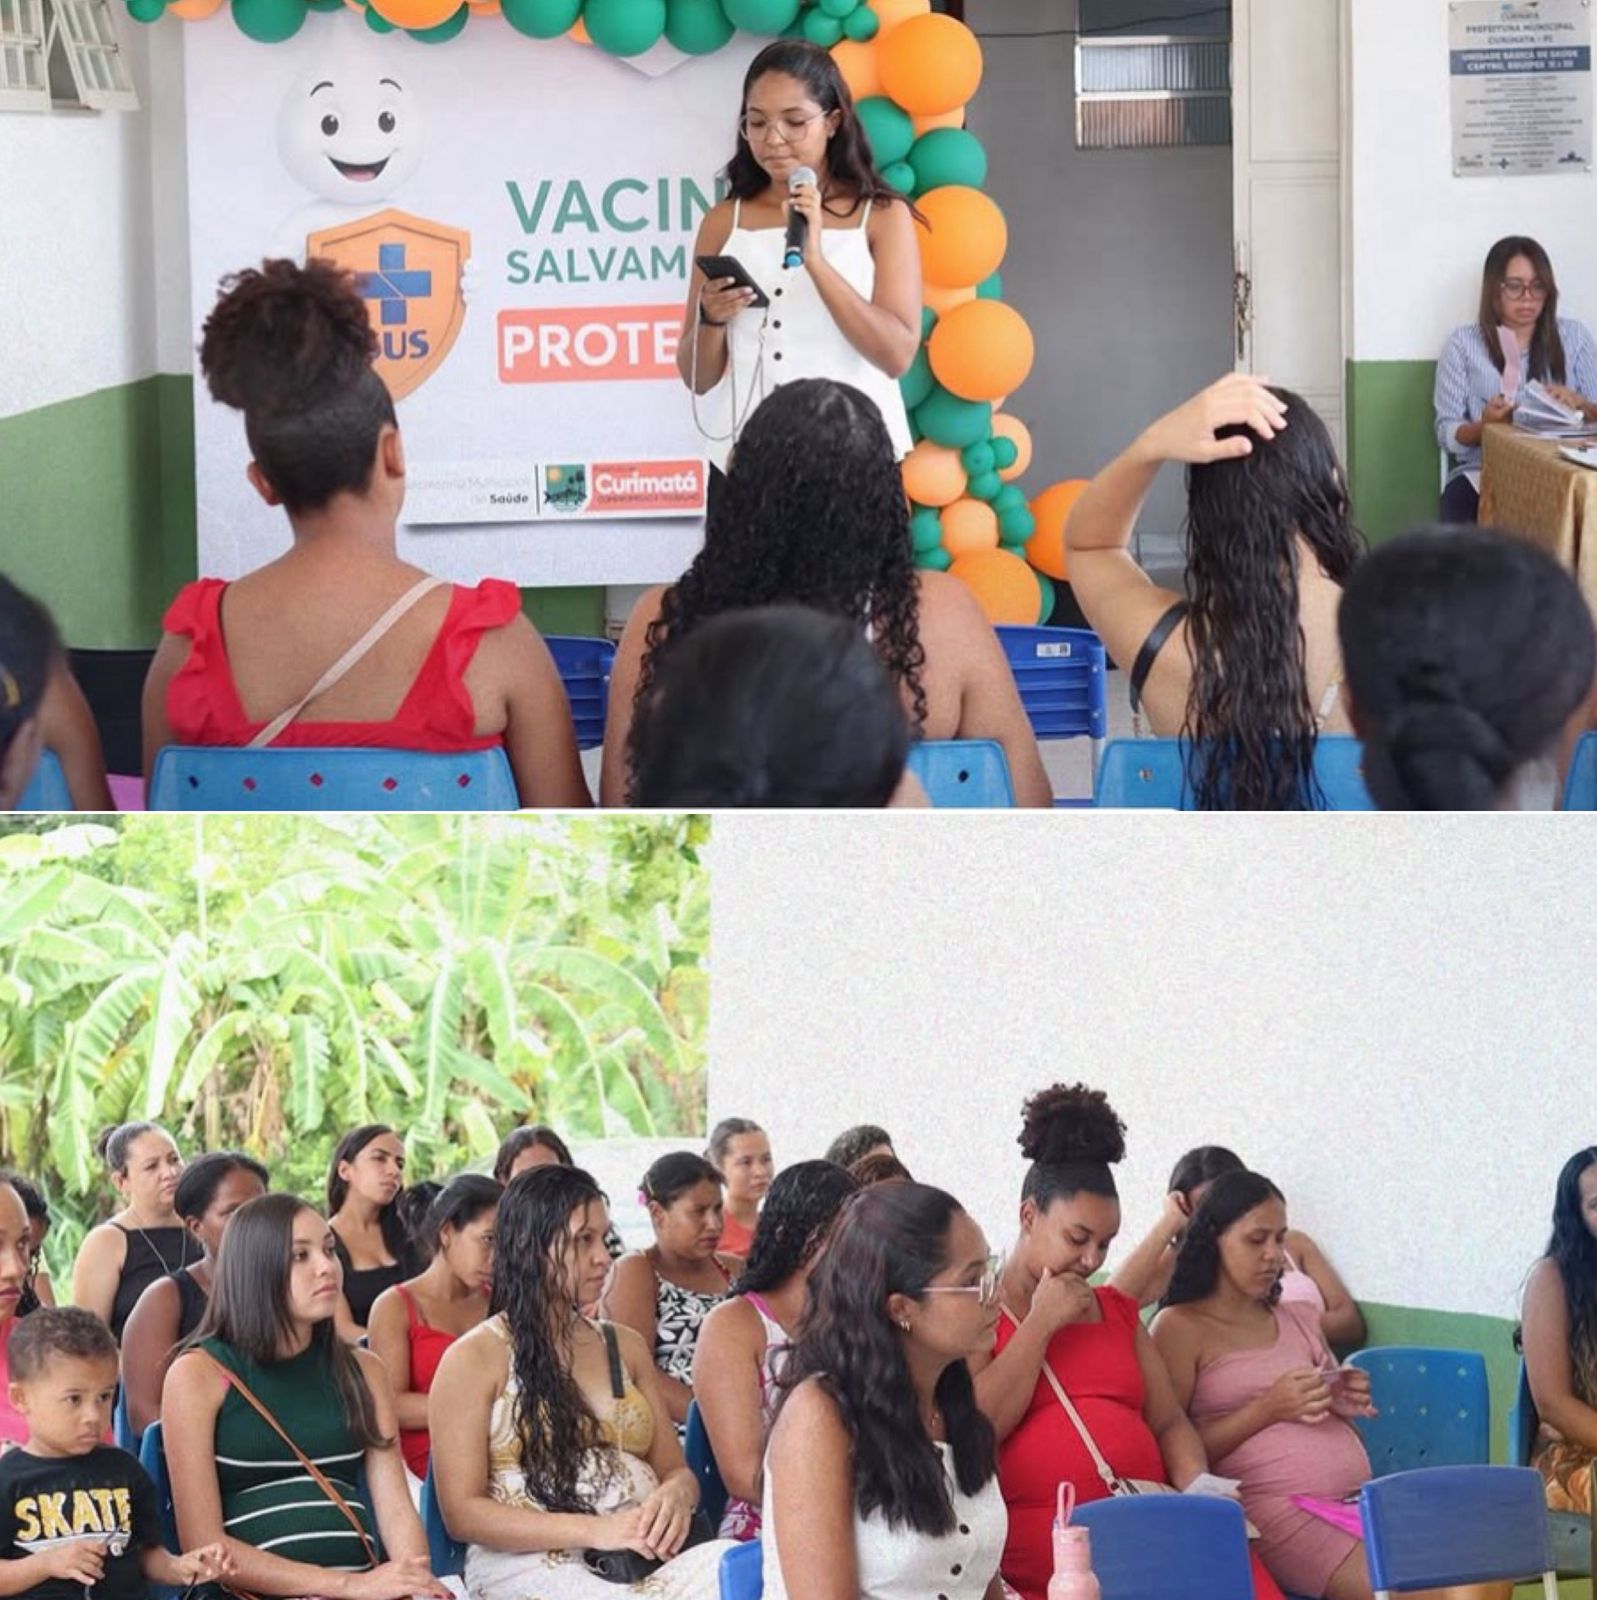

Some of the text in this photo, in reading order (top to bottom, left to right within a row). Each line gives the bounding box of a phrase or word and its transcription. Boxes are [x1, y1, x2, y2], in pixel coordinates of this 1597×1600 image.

[507, 246, 686, 284] SALVAM
[504, 321, 681, 369] PROTE
[489, 492, 529, 504] Saúde
[595, 470, 698, 495] Curimatá
[15, 1487, 131, 1542] SKATE
